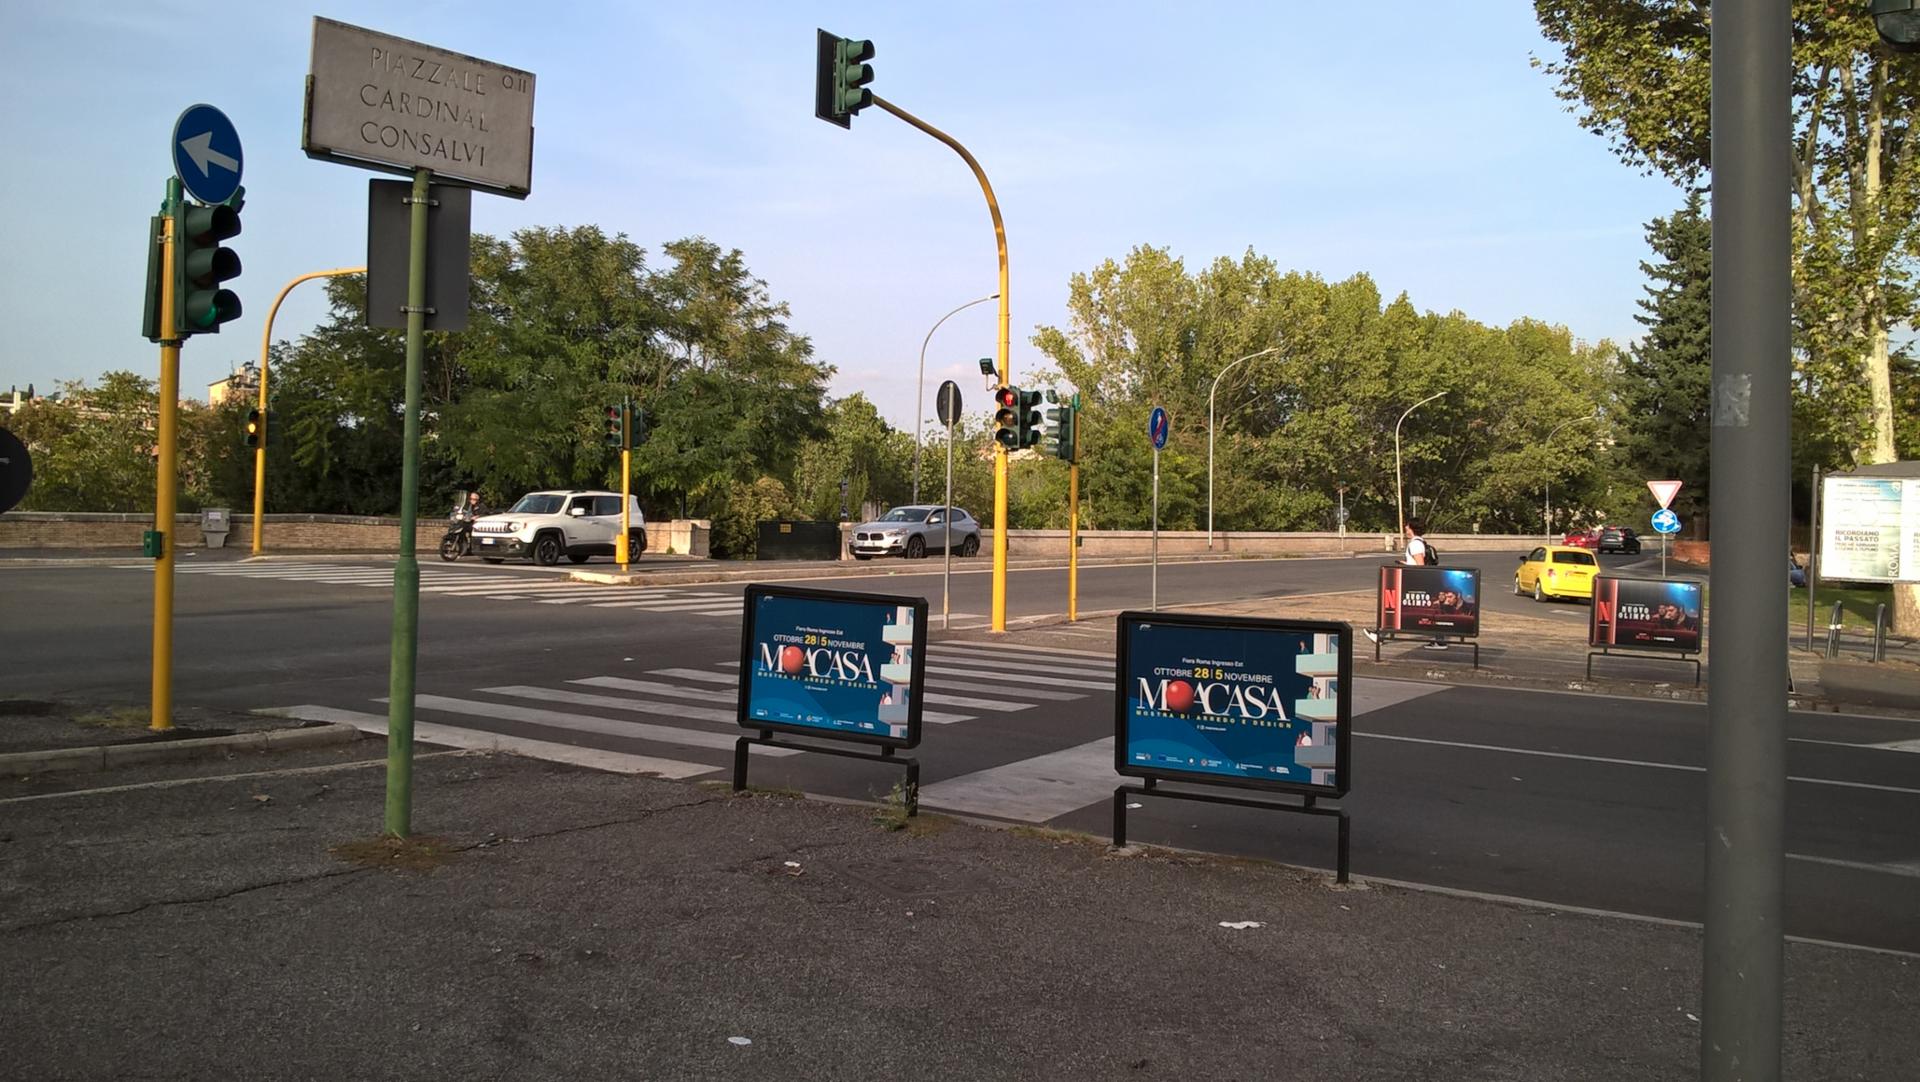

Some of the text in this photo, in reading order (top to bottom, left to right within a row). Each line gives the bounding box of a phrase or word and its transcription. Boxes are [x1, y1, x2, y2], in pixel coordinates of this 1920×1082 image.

[371, 47, 486, 96] PIAZZALE
[360, 83, 488, 132] CARDINAL
[360, 121, 486, 167] CONSALVI
[1402, 599, 1431, 607] OLIMPO
[1621, 605, 1649, 614] NUOVO
[1618, 612, 1650, 620] OLIMPO
[773, 633, 865, 650] OTTOBRE 28 5 NOVEMBRE
[1153, 667, 1273, 684] OTTOBRE 28 5 NOVEMBRE
[1135, 709, 1174, 719] MOSTRA
[1196, 715, 1236, 724] ARREDO
[1252, 720, 1292, 729] DESIGN
